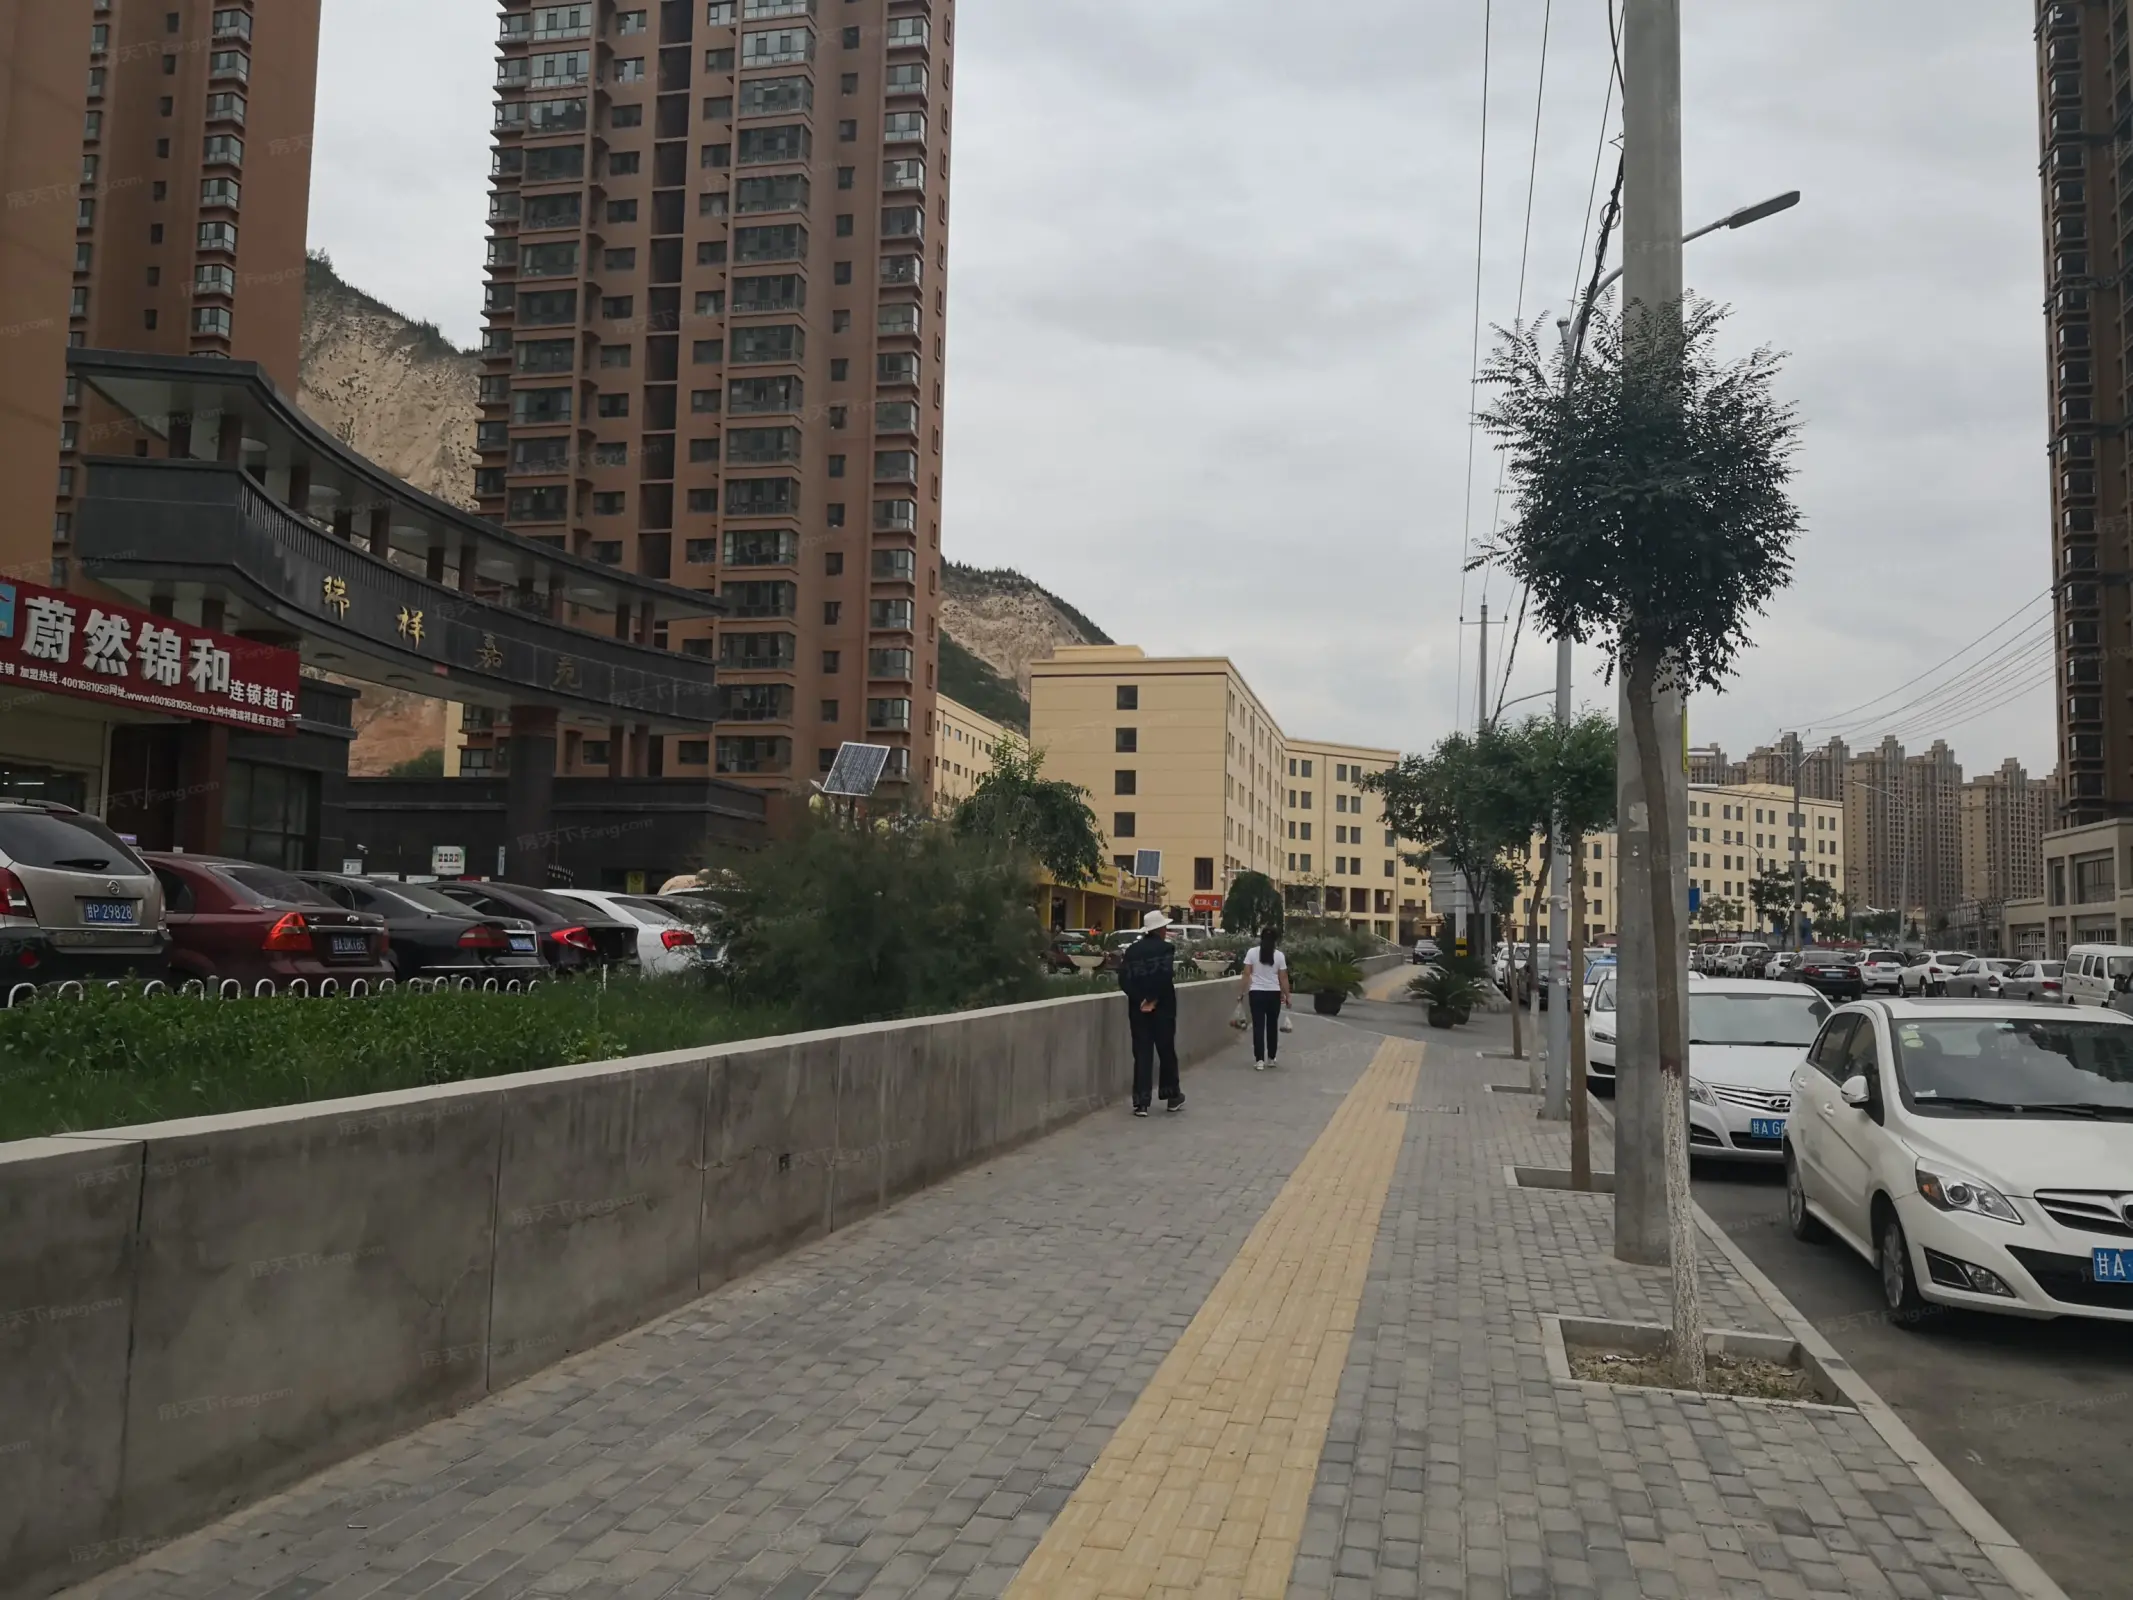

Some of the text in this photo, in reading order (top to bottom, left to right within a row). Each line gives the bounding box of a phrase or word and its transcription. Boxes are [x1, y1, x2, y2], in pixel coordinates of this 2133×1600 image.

[21, 596, 230, 693] 蔚然锦和
[323, 575, 582, 690] 瑞祥嘉苑
[229, 680, 295, 712] 连锁超市
